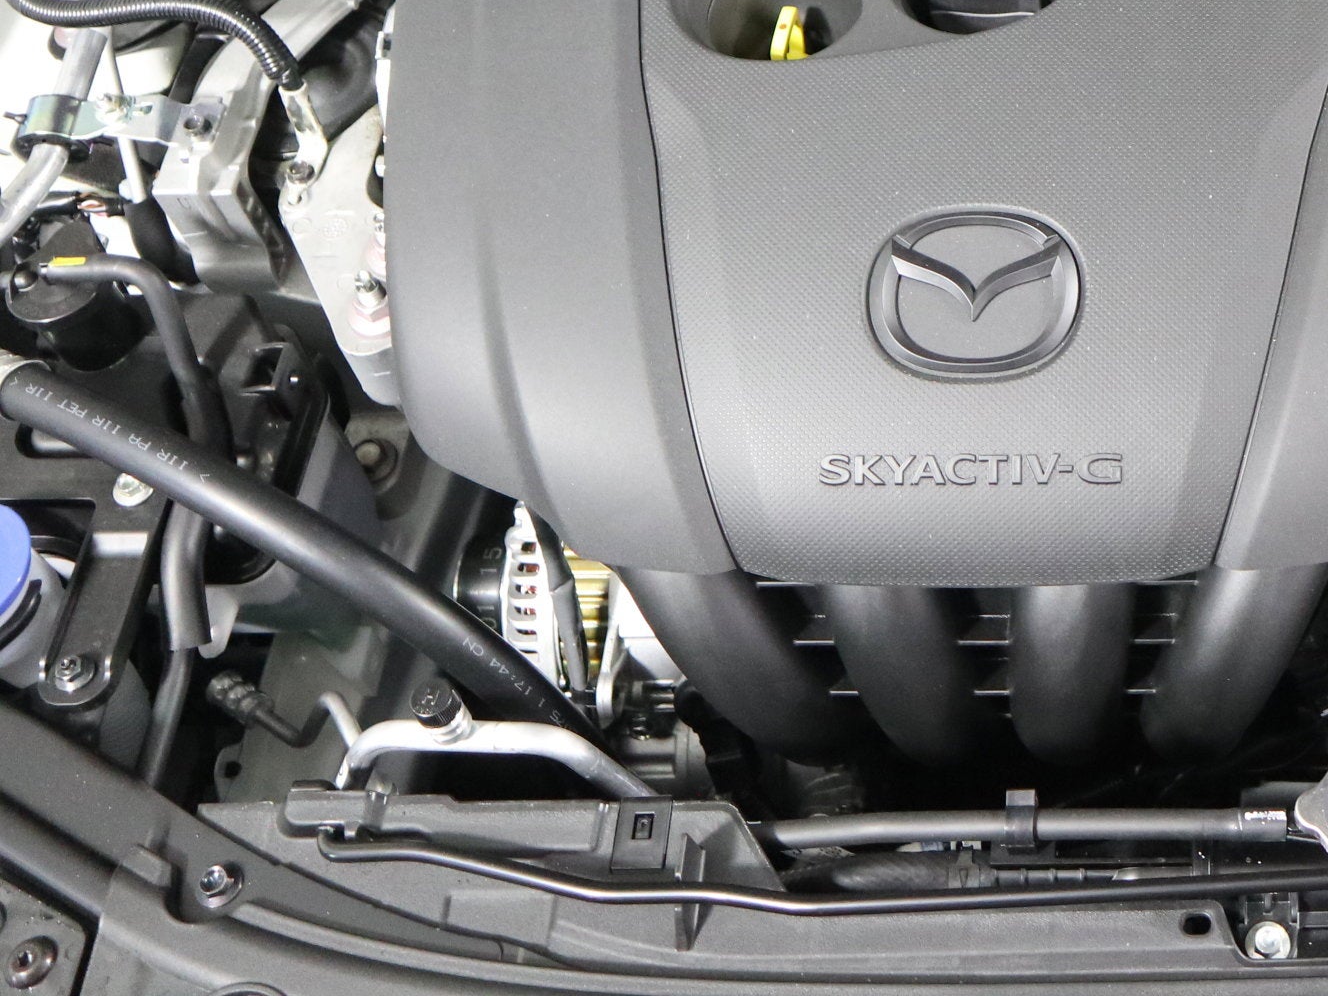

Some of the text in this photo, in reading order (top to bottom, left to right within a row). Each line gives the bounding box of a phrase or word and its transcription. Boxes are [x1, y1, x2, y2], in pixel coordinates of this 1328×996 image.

[56, 397, 89, 419] PET
[127, 432, 153, 452] PA
[818, 453, 1123, 486] SKYACTIV-G
[462, 636, 485, 657] CN
[489, 658, 533, 696] 17:44
